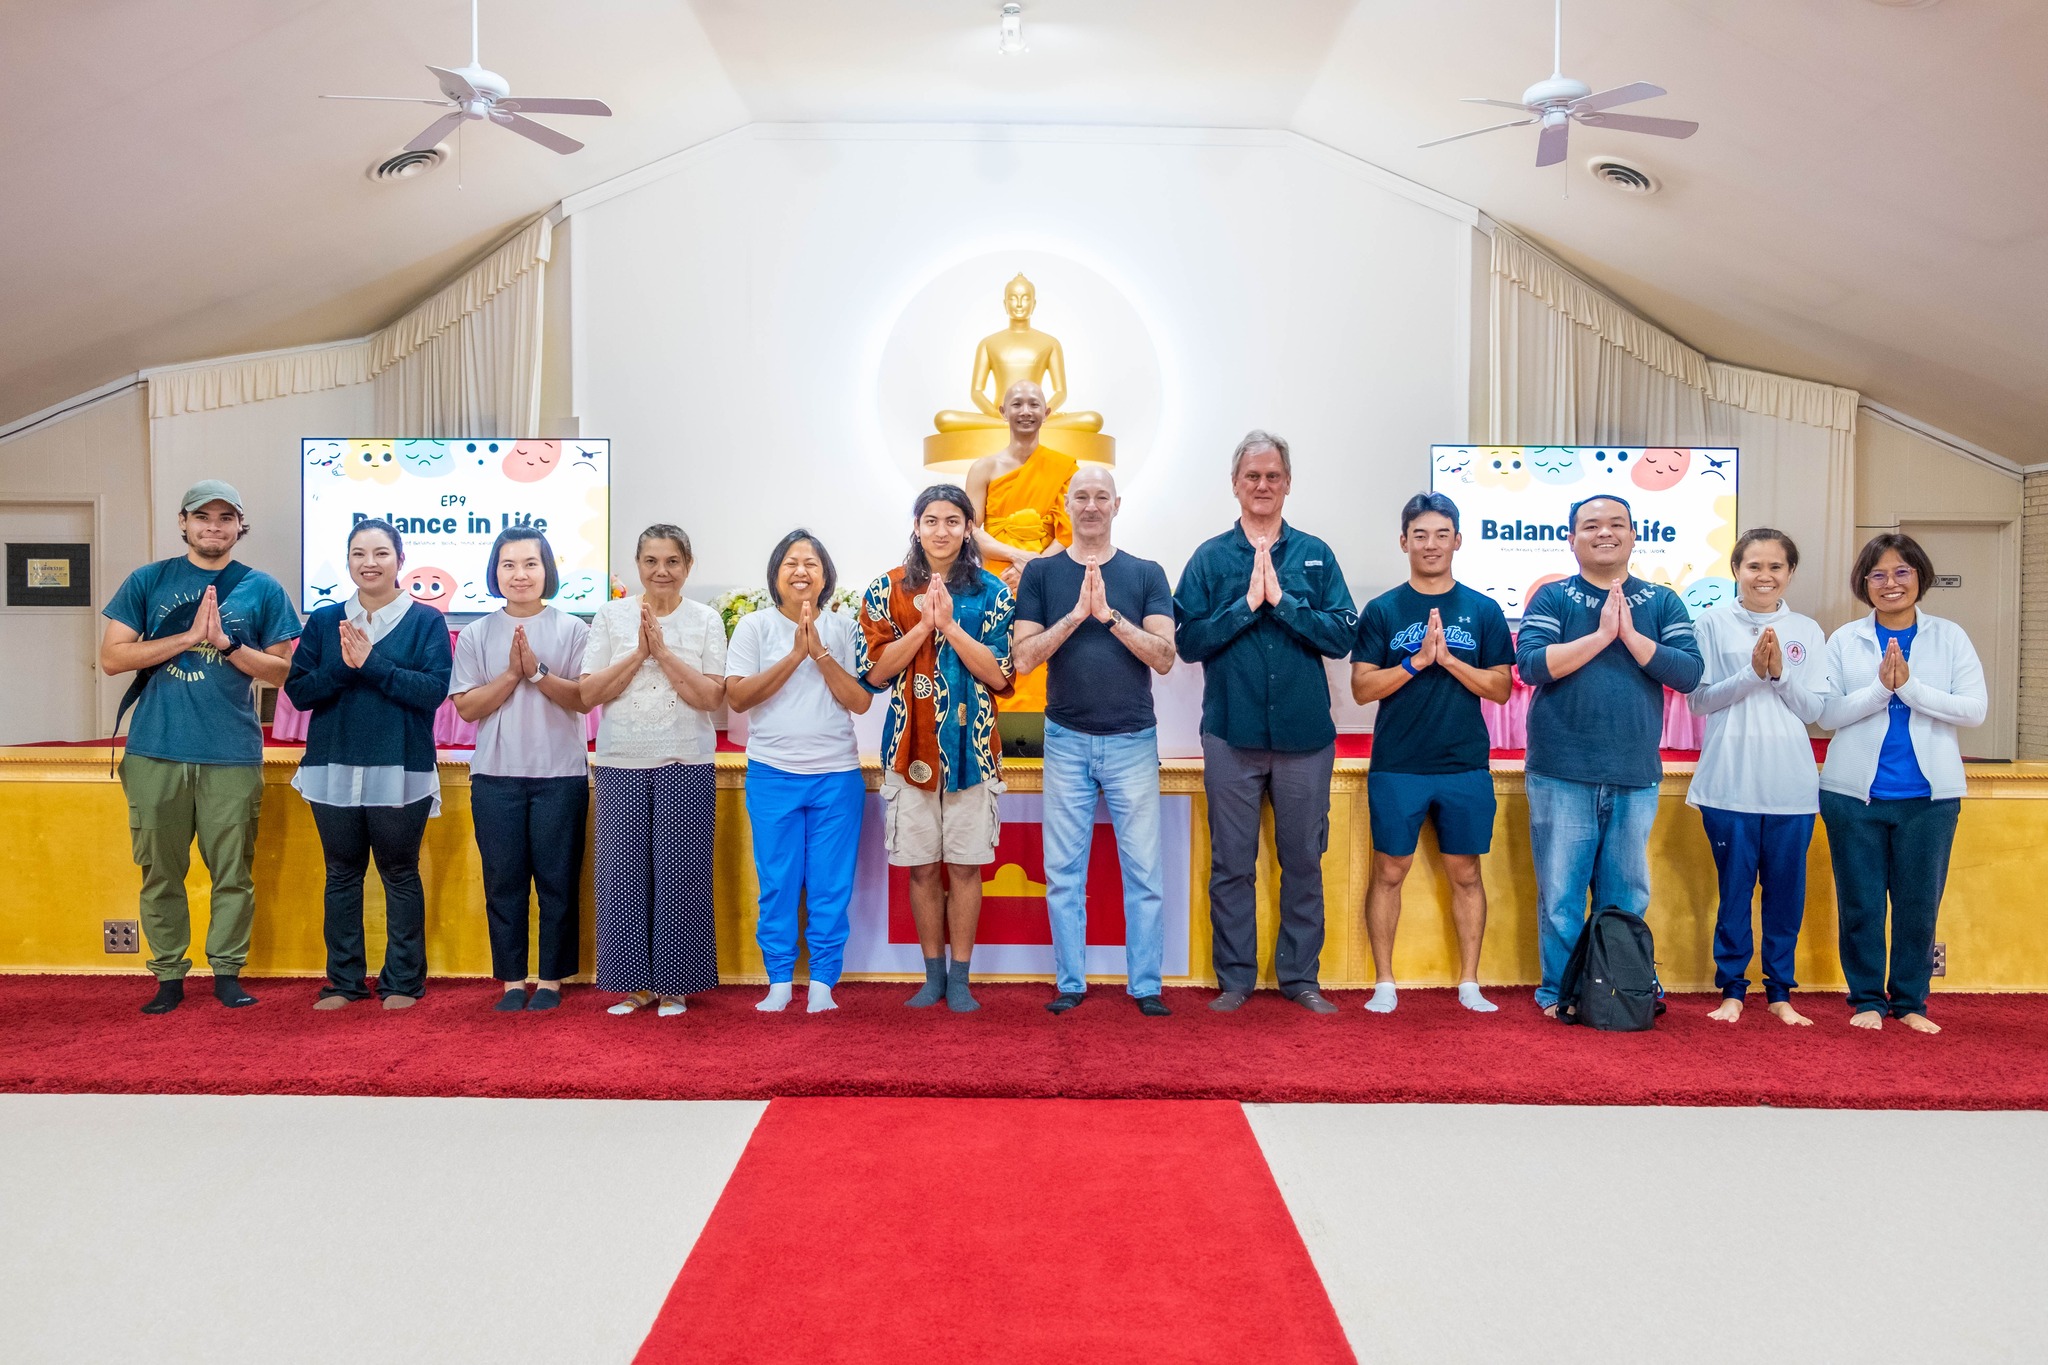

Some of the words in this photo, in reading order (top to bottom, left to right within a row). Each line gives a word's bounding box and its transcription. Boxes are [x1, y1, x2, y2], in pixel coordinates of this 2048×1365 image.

[441, 494, 466, 507] EP9
[468, 511, 491, 533] in
[1481, 519, 1569, 541] Balanc
[1564, 586, 1600, 609] NEW
